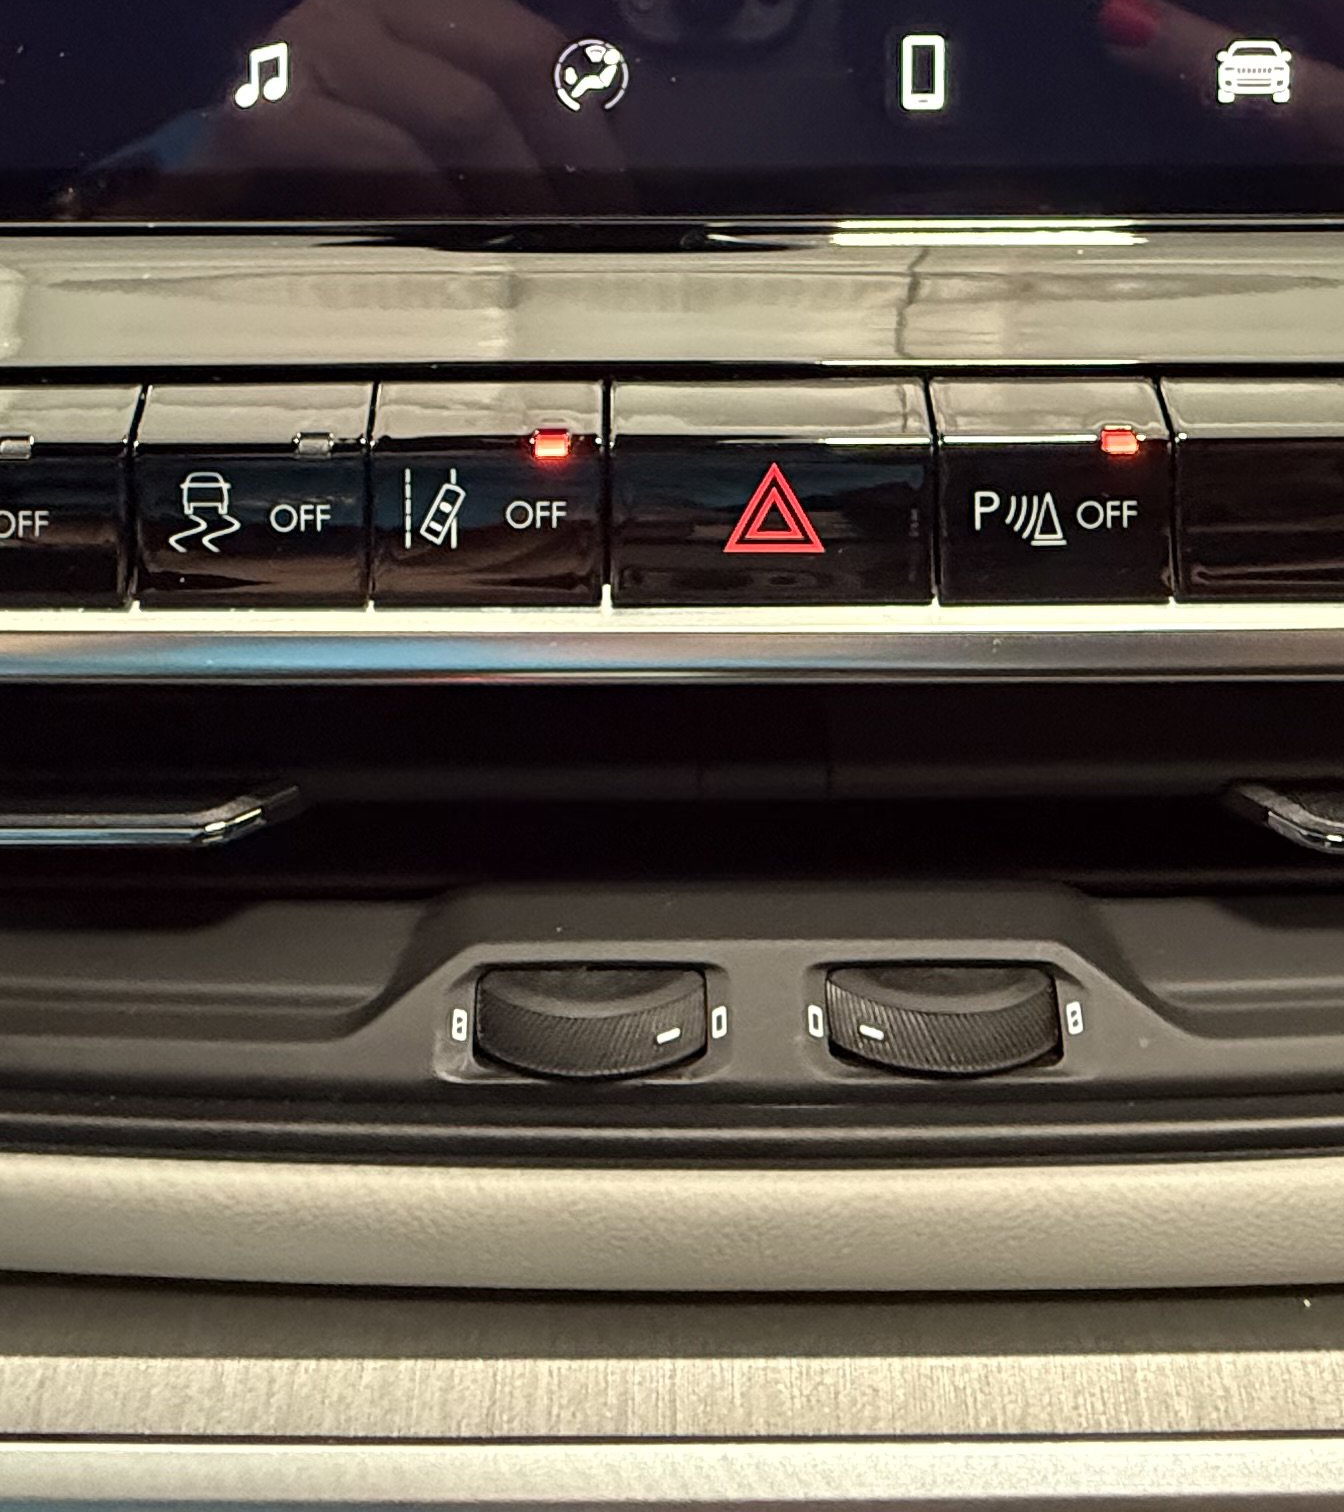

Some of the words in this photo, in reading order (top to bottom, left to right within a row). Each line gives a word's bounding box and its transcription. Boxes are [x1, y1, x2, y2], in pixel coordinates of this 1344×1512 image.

[269, 503, 331, 533] OFF
[505, 500, 567, 529] OFF
[1076, 500, 1138, 530] OFF
